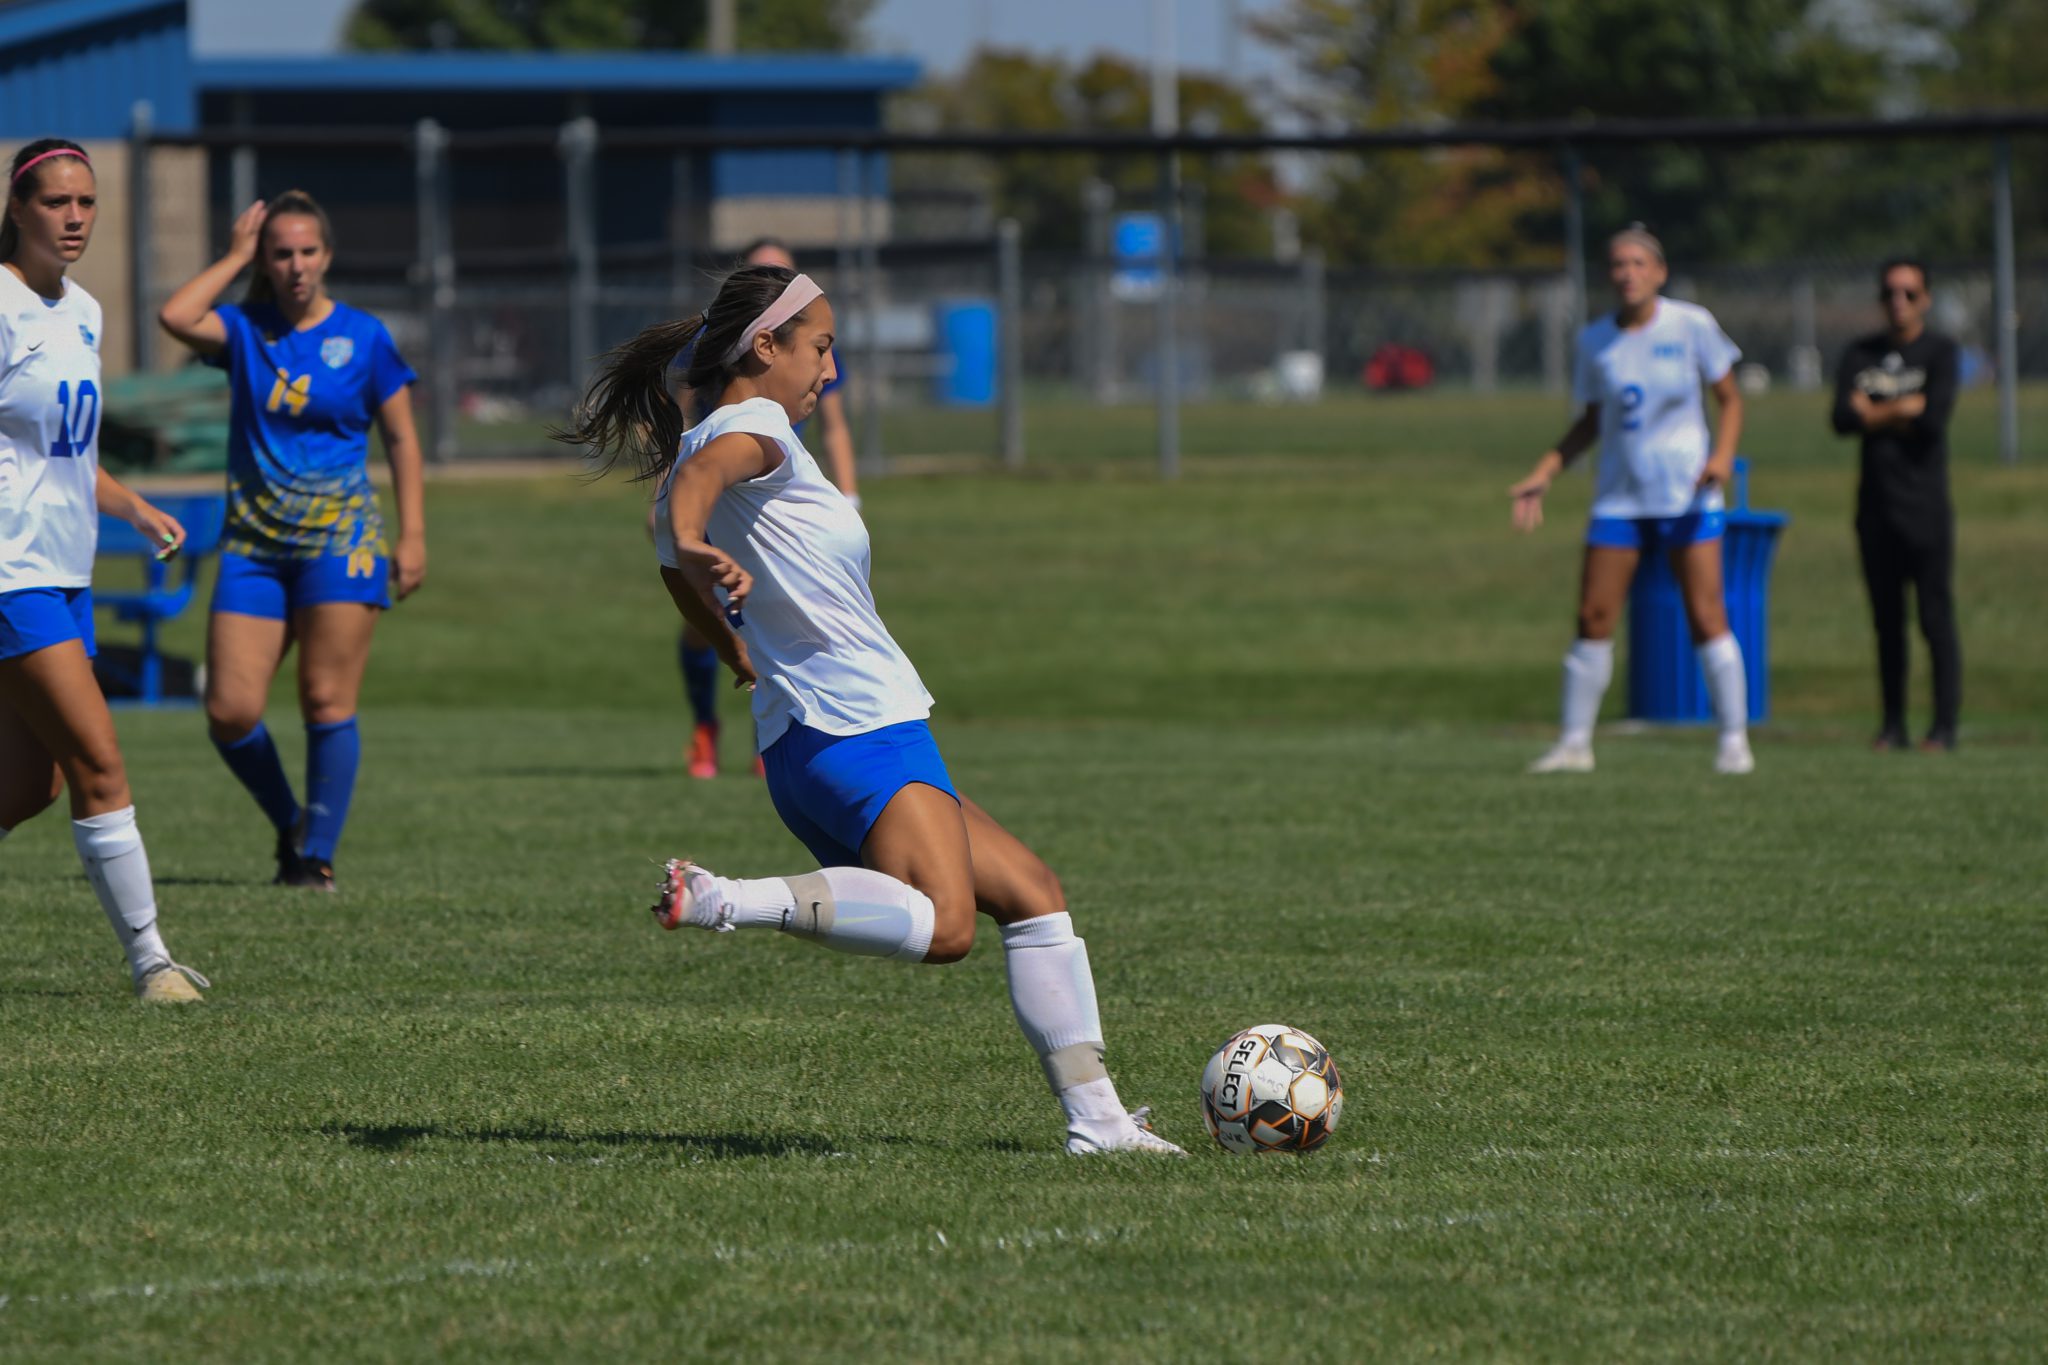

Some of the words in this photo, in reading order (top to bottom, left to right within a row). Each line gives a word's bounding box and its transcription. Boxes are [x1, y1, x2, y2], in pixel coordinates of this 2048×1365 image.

[50, 380, 97, 457] 10
[266, 367, 312, 416] 14
[1221, 1039, 1257, 1112] SELECT
